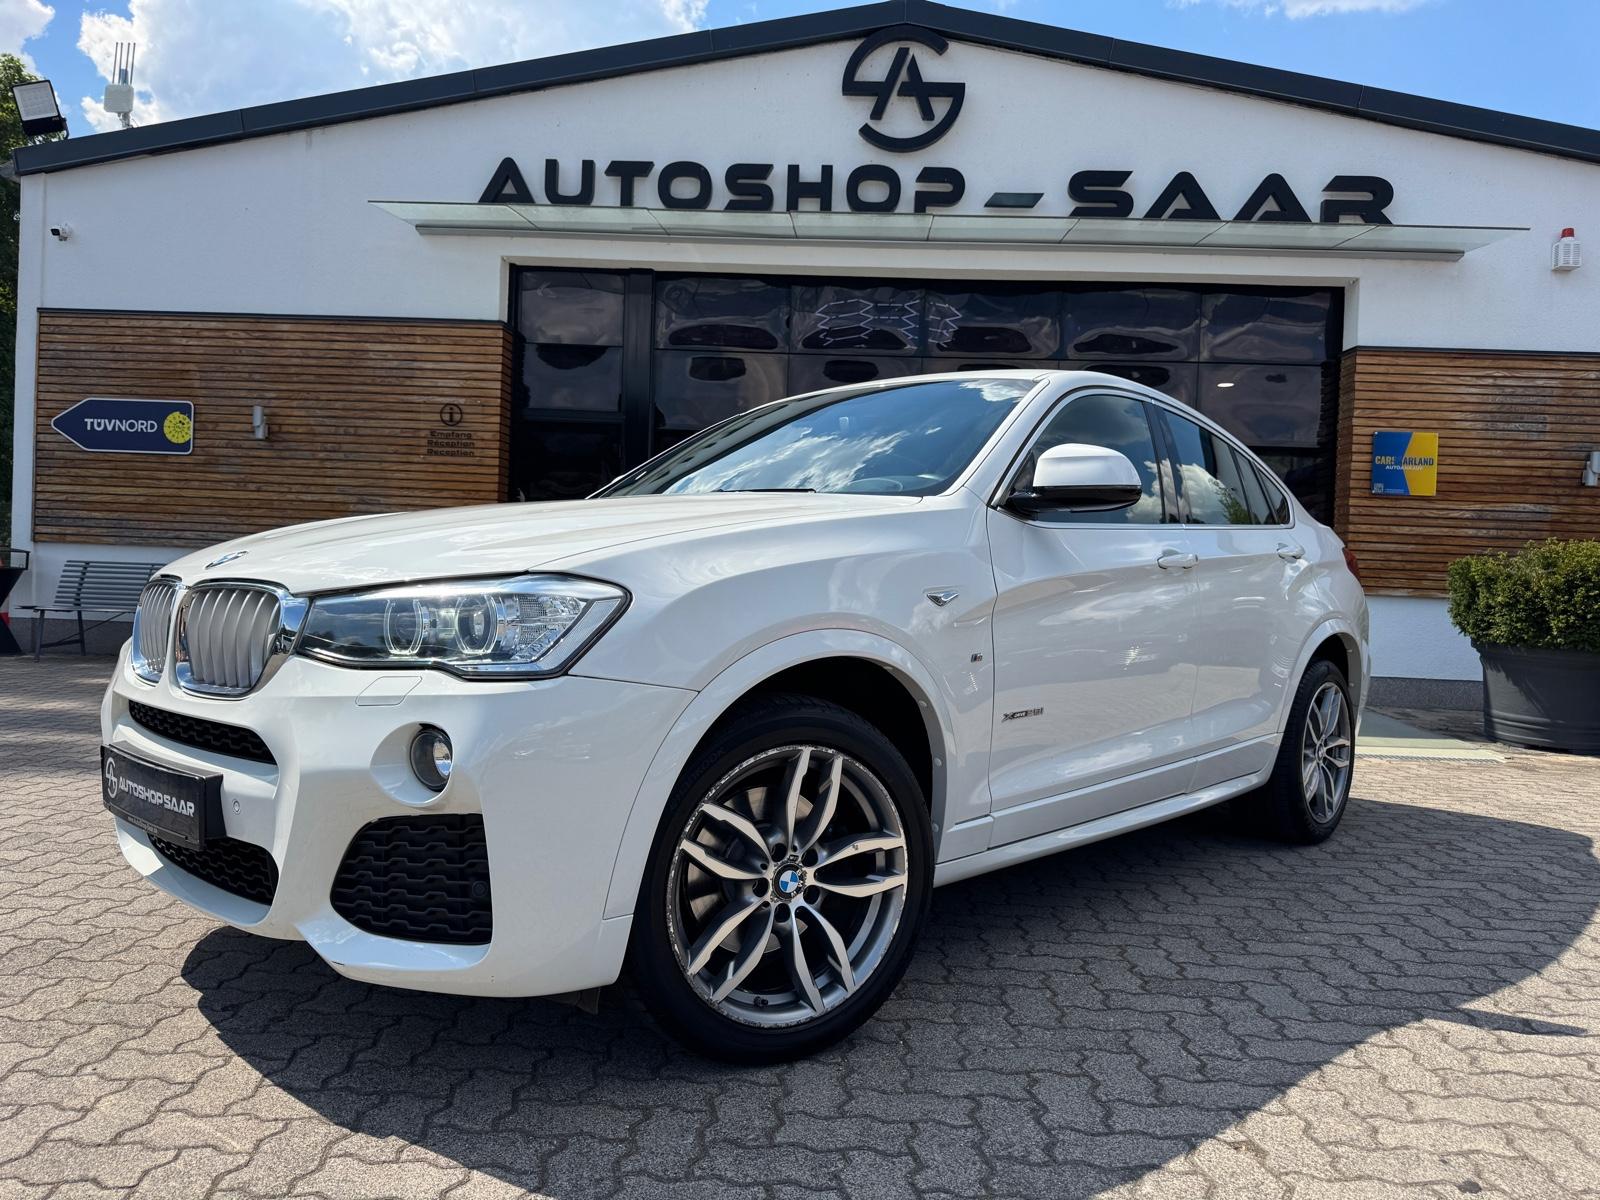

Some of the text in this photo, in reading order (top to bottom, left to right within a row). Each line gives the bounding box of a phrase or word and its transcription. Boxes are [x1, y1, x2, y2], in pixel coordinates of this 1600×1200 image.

[478, 157, 966, 213] AUTOSHOP
[1068, 170, 1395, 225] SAAR
[119, 776, 195, 817] AUTOSHOP SAAR
